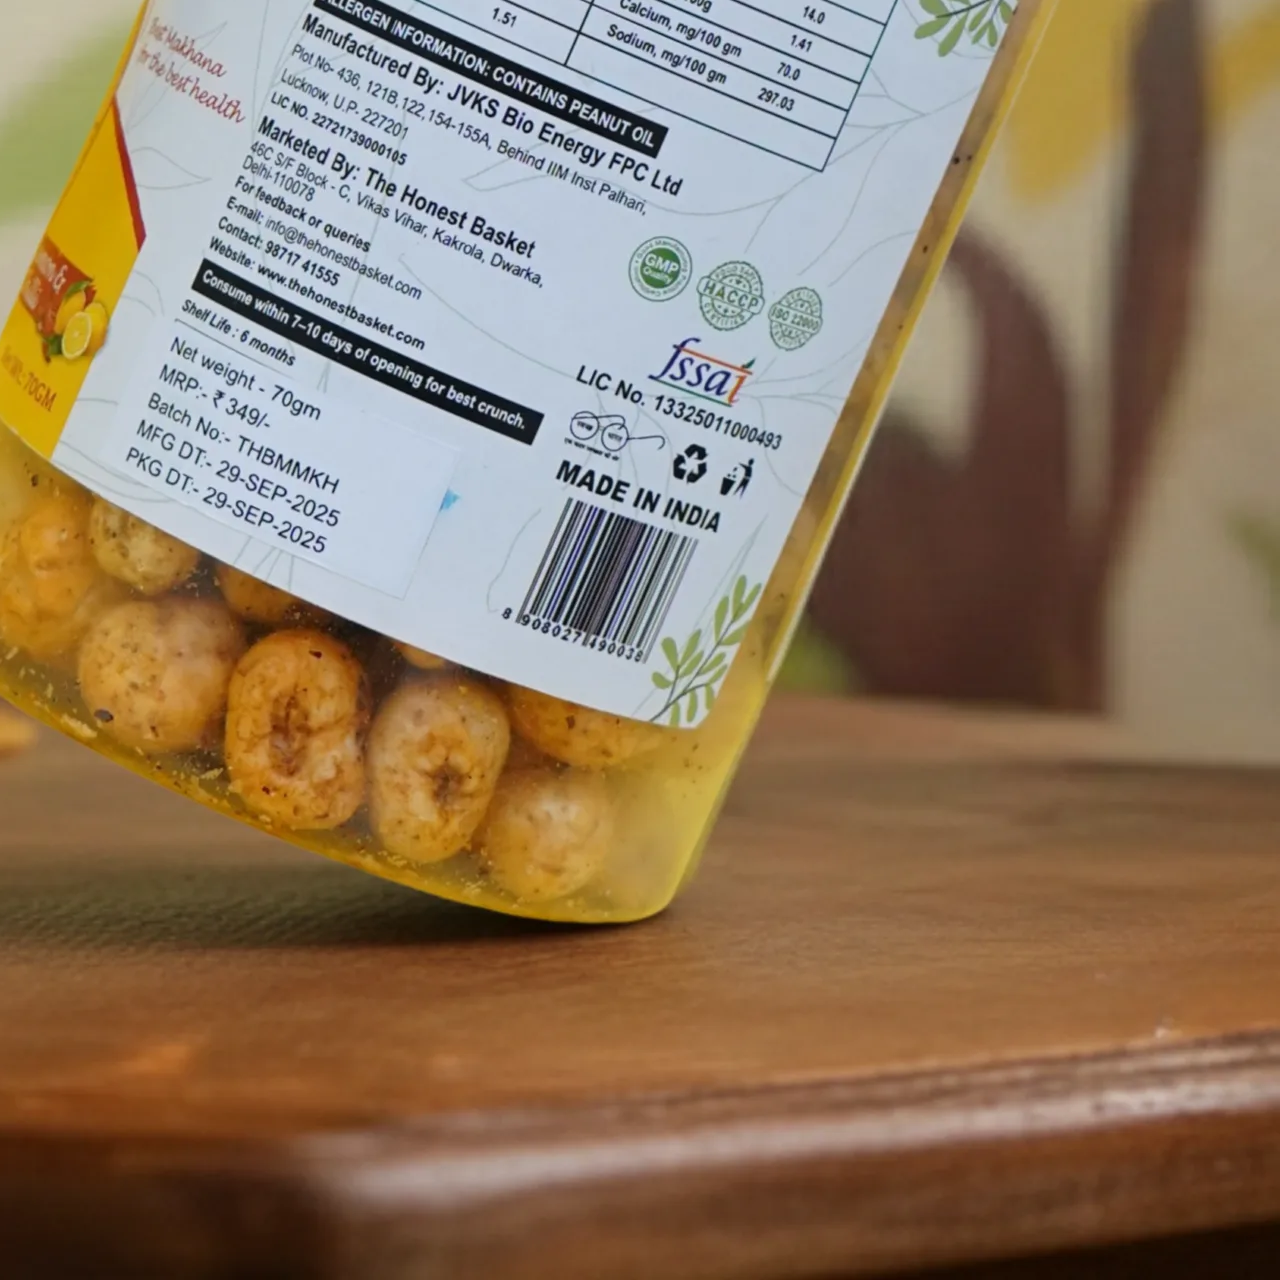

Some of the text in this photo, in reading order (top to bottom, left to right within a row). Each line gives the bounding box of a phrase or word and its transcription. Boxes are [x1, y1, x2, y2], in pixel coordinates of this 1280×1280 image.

[280, 68, 329, 106] Lucknow,
[360, 107, 409, 140] 227201
[291, 43, 314, 65] Plot
[336, 67, 361, 90] 436,
[366, 80, 491, 150] 121B,122,154-155A,
[496, 139, 546, 171] Behind
[546, 160, 570, 180] IIM
[570, 171, 597, 193] Inst
[598, 182, 646, 216] Palhari,
[301, 13, 683, 196] Manufactured By: JVKS Bio Energy FPC Ltd
[390, 19, 491, 76] INFORMATION:
[492, 66, 568, 109] CONTAINS
[568, 99, 632, 135] PEANUT
[631, 126, 654, 147] OIL
[234, 175, 371, 253] For feedback or queries
[242, 155, 316, 202] Delhi-110078
[257, 115, 535, 258] Marketed By: The Honest Basket
[209, 236, 425, 350] Website: www.thehonestbasket.com
[218, 215, 340, 286] Contact: 98717 41555
[226, 195, 422, 300] E-mail: info@thehonestbasket.com
[643, 252, 680, 276] GMP
[703, 279, 760, 311] HACCP
[202, 269, 253, 305] Consume
[254, 298, 290, 324] within
[321, 330, 353, 354] days
[354, 347, 371, 361] of
[369, 354, 424, 389] opening
[424, 375, 446, 395] for
[446, 384, 477, 409] best
[477, 401, 525, 429] crunch.
[648, 339, 755, 407] fssai
[147, 392, 191, 427] Batch
[238, 434, 340, 494] THBMMKH
[212, 389, 225, 408] ₹
[576, 364, 612, 391] LIC
[614, 379, 645, 406] No.
[655, 394, 782, 450] 13325011000493
[125, 446, 163, 477] PKG
[202, 486, 327, 553] 29-SEP-2025
[136, 419, 176, 451] MFG
[215, 459, 340, 527] 29-SEP-2025
[555, 459, 720, 533] MADE IN INDIA
